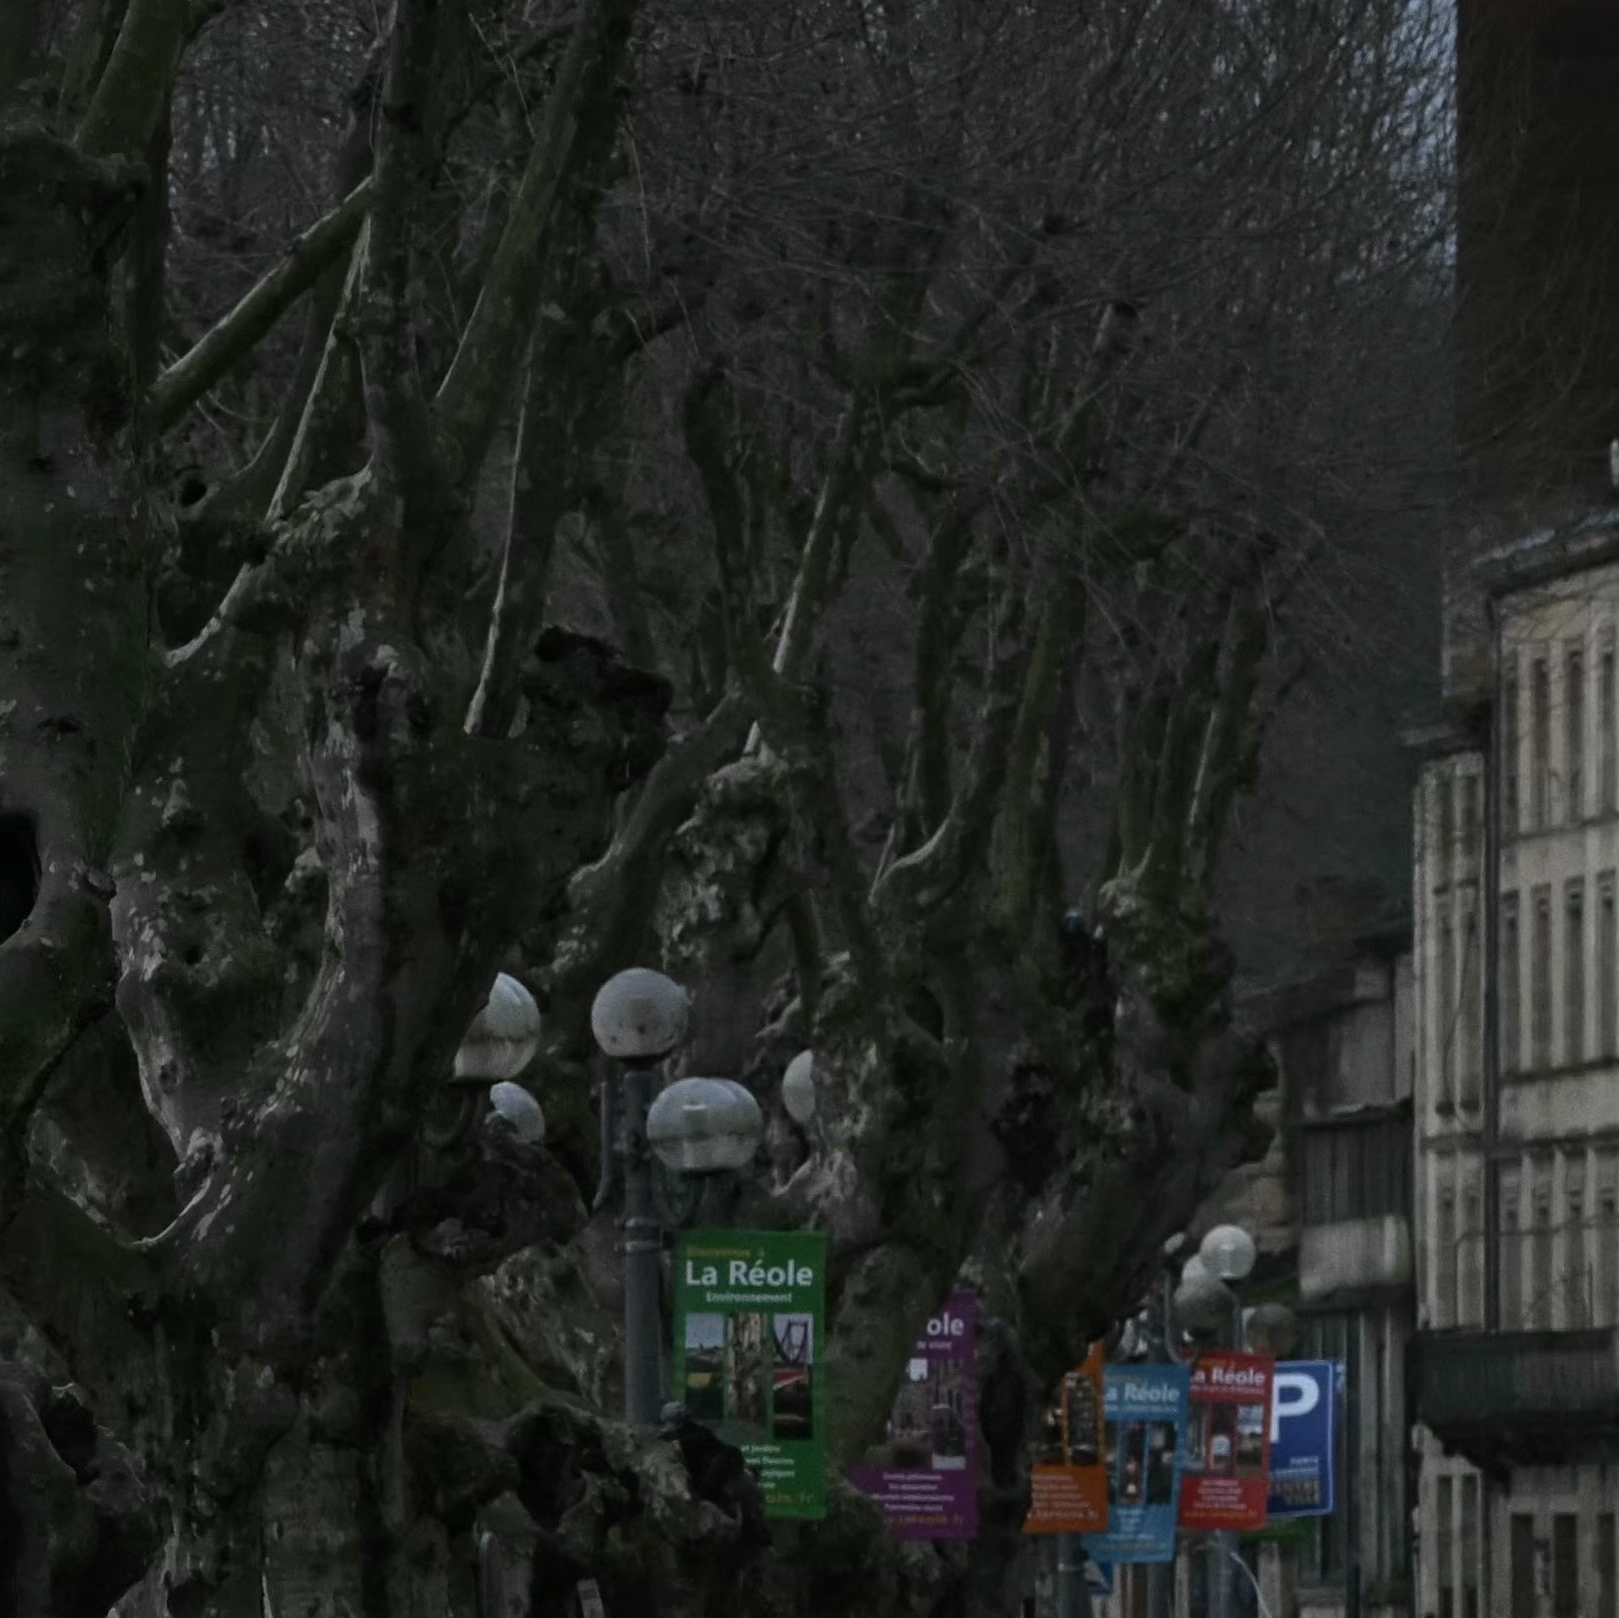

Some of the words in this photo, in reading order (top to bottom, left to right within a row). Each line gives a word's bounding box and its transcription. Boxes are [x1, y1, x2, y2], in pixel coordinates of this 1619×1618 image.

[685, 1259, 718, 1286] La
[729, 1258, 813, 1286] Réole
[927, 1312, 964, 1336] ole
[1211, 1367, 1265, 1385] Réole
[1270, 1372, 1319, 1444] P
